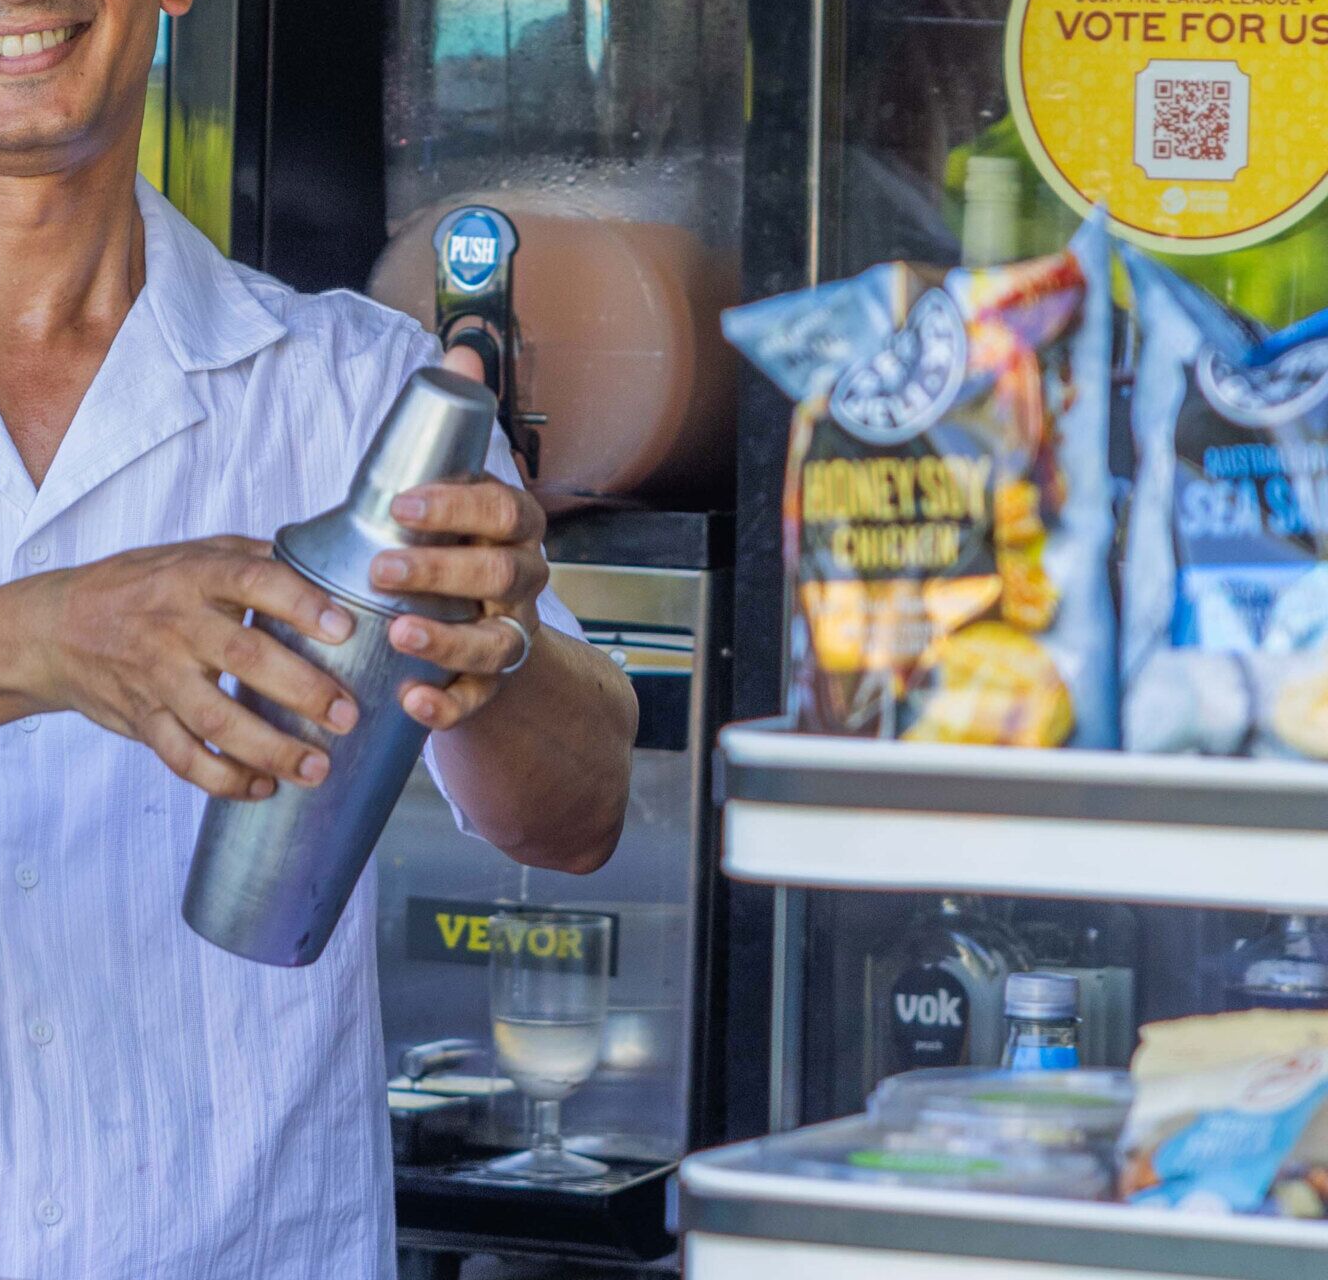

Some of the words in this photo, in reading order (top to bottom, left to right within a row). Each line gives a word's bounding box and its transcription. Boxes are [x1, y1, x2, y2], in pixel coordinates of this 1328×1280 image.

[1055, 10, 1167, 42] VOTE
[1180, 12, 1266, 44] FOR
[1279, 13, 1328, 45] US
[450, 235, 497, 264] PUSH
[803, 458, 915, 524] HONEY
[915, 454, 993, 519] SOY
[832, 522, 960, 569] CHICKEN
[896, 987, 963, 1027] vok
